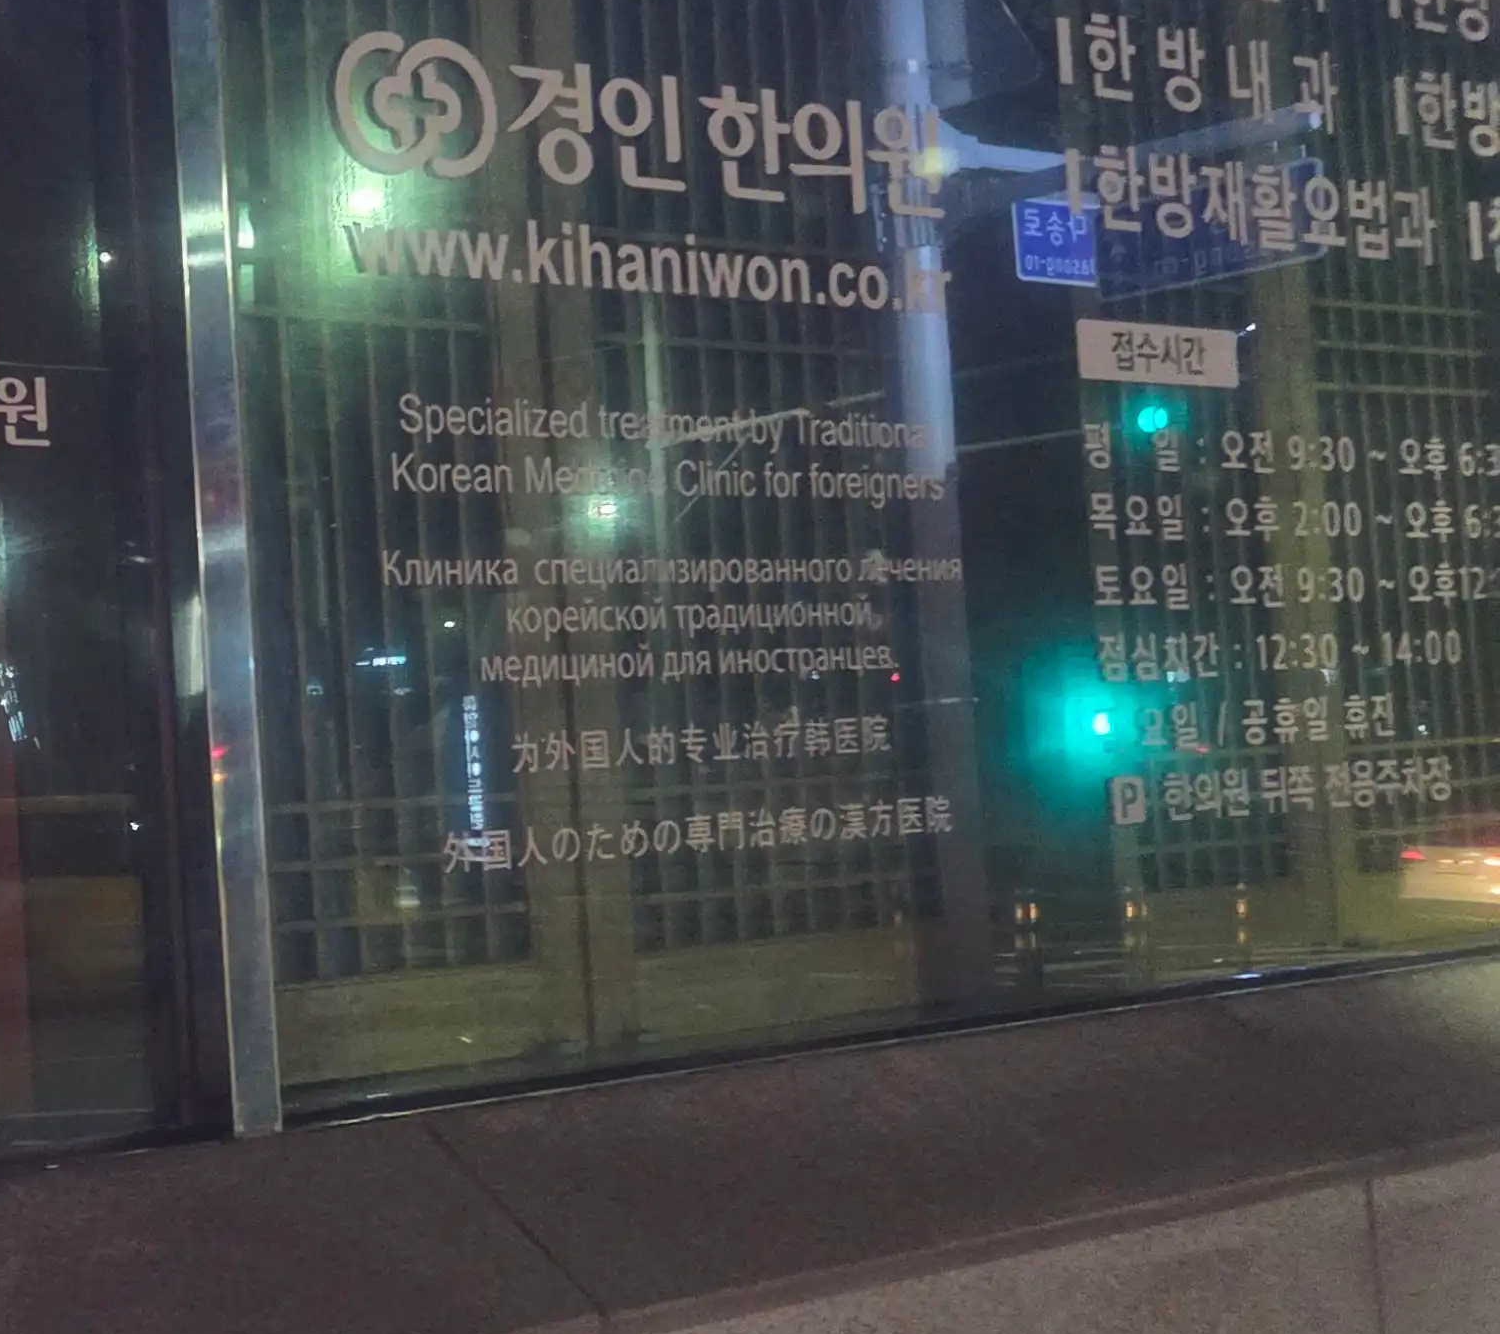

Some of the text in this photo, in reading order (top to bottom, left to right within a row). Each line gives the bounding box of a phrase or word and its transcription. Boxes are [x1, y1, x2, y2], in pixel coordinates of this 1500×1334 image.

[508, 63, 945, 219] 경인 한의원
[1093, 145, 1440, 267] 한방재활요법과
[350, 219, 953, 313] www.kihaniwon.co.kr
[1110, 329, 1206, 377] 접수시간
[398, 392, 590, 443] Specialized
[749, 407, 784, 455] by
[795, 411, 929, 450] Traditiona
[390, 451, 514, 495] Korean
[676, 458, 757, 498] Clinic
[763, 461, 803, 499] for
[808, 462, 946, 510] foreigners
[1220, 429, 1277, 474] 오전
[1287, 434, 1357, 473] 9:30
[1399, 436, 1449, 481] 오후
[1224, 495, 1280, 542] 오후
[1292, 500, 1363, 537] 2:00
[1404, 499, 1455, 544] 오후
[380, 550, 519, 587] Клиника
[533, 557, 852, 592] специализированного
[1229, 563, 1286, 609] 오전
[1296, 566, 1366, 604] 9:30
[505, 593, 873, 642] корейской традиционной
[480, 642, 655, 689] медициной
[660, 649, 713, 685] для
[1255, 632, 1340, 672] 12:30
[1381, 629, 1463, 668] 14:00
[1241, 695, 1330, 746] 공휴일
[1343, 692, 1397, 740] 휴진
[1163, 767, 1251, 822] 한의원
